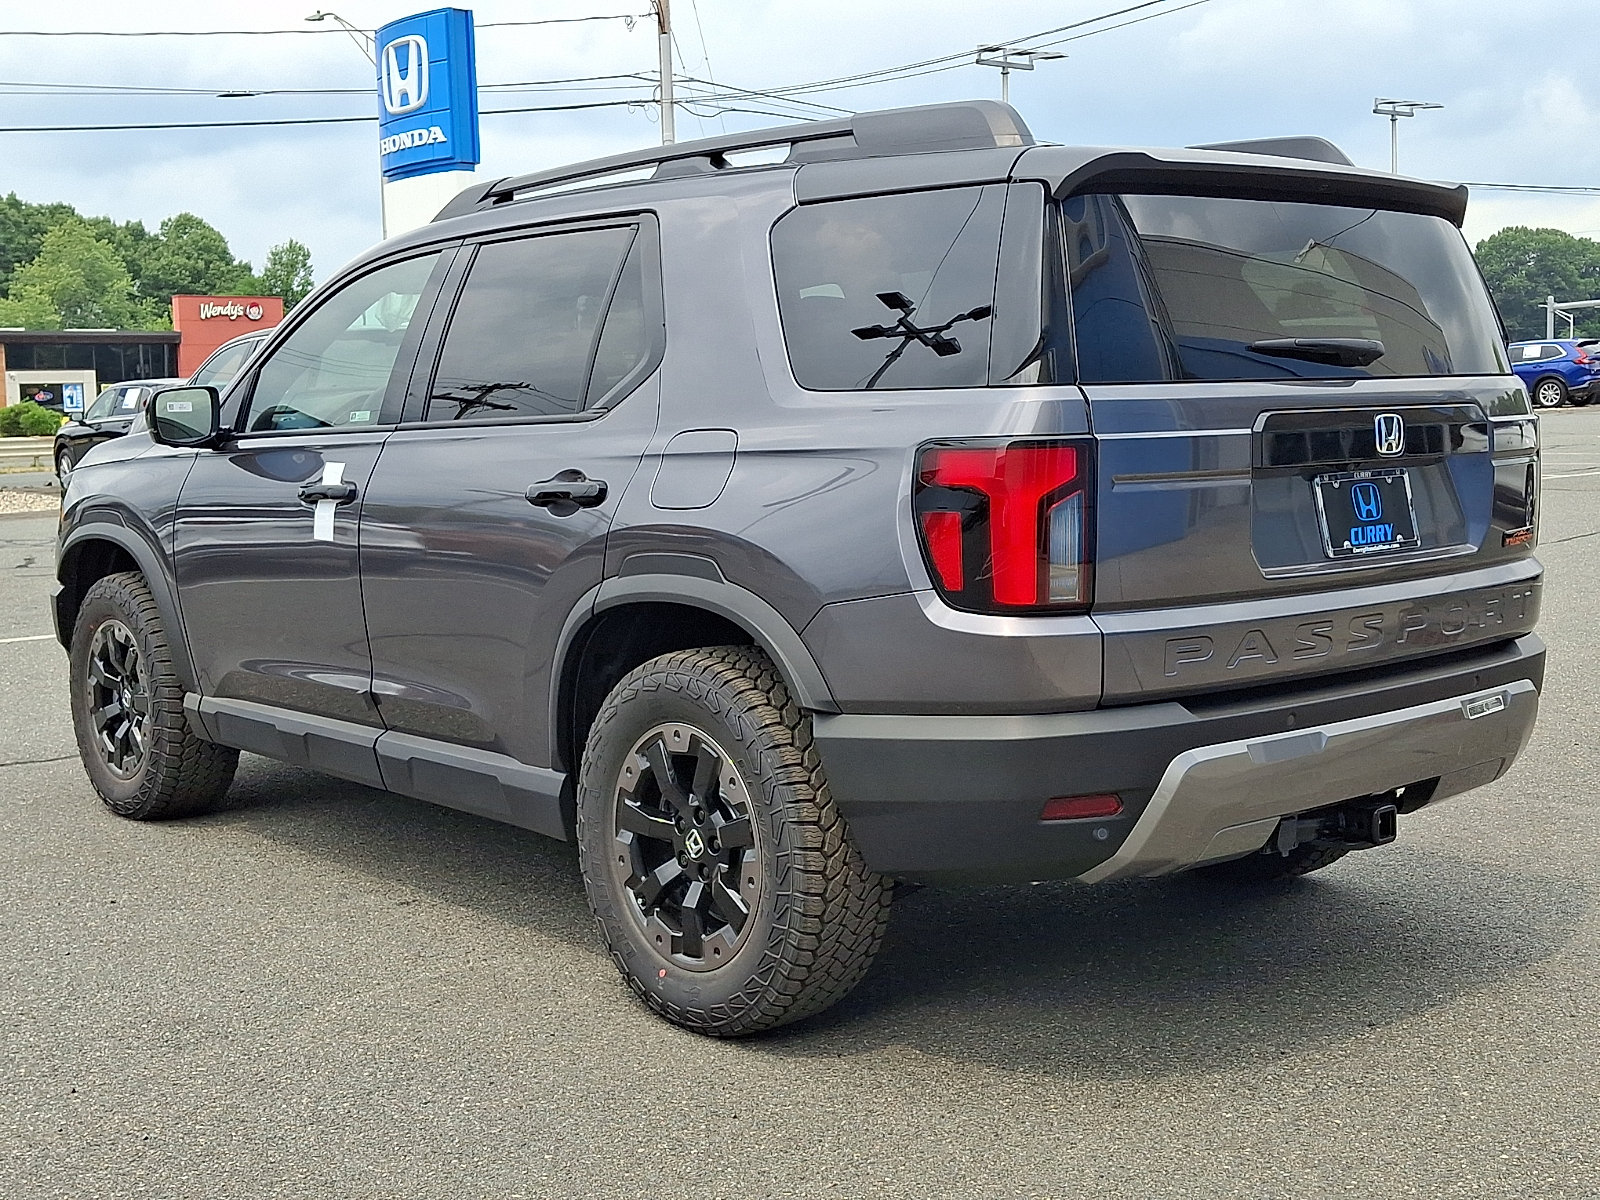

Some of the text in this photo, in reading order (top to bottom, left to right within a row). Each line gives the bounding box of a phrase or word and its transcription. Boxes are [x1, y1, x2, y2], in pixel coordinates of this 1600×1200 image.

[380, 126, 447, 156] HONDA
[200, 300, 244, 320] Wendy's
[1350, 523, 1394, 545] CURRY
[1164, 590, 1532, 677] PASSPORT
